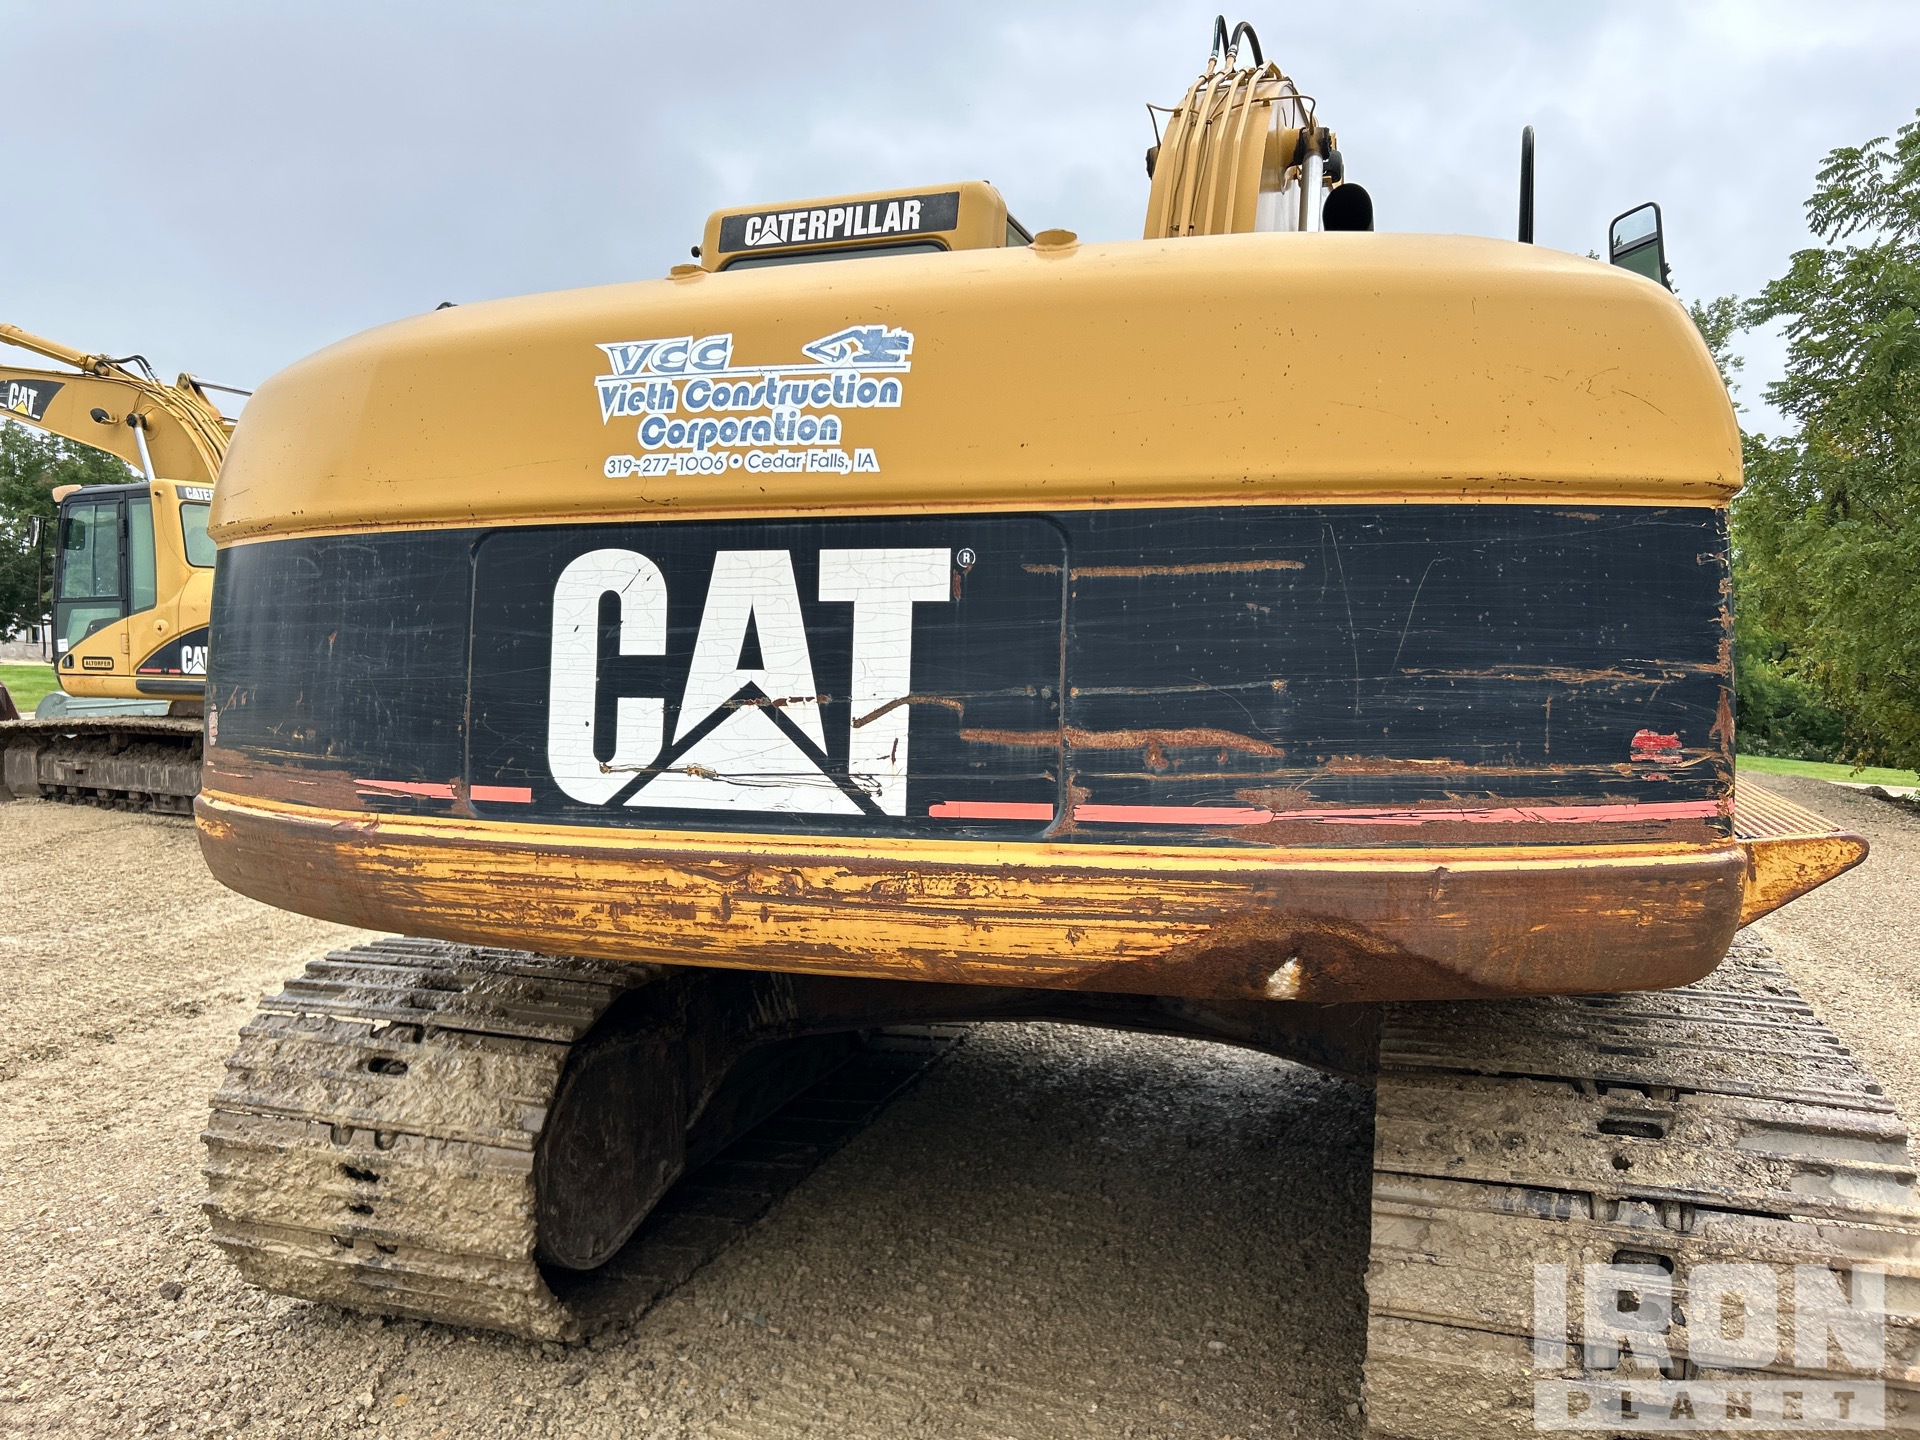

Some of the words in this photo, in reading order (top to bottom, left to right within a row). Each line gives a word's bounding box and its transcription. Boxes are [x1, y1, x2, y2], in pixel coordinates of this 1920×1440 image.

[744, 199, 922, 246] CATERPILLAR
[605, 337, 730, 375] VCC
[8, 382, 38, 417] CAT
[600, 380, 675, 416] Vieth
[685, 373, 899, 410] Construction
[641, 411, 838, 450] Corporation
[607, 457, 724, 474] 319-277-1006
[748, 454, 802, 469] Cedar
[810, 453, 849, 470] Falls,
[857, 453, 875, 468] IA
[547, 547, 952, 817] CAT
